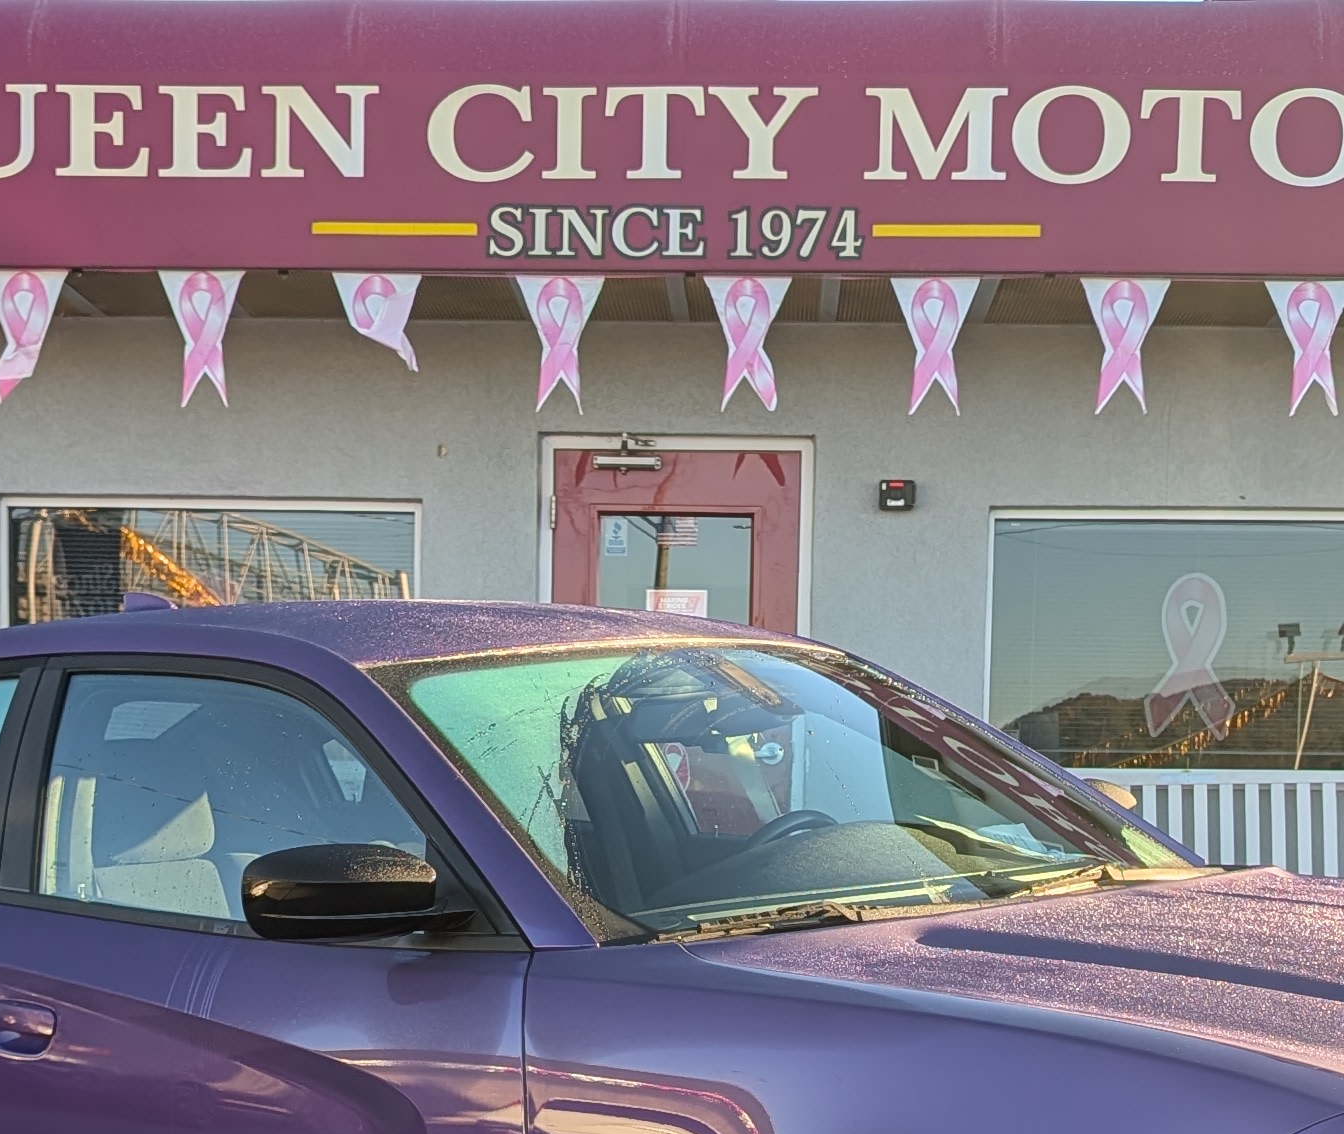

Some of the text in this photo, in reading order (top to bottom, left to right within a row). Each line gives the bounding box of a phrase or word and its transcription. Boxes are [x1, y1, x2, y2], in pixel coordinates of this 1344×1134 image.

[425, 84, 819, 184] CITY
[486, 205, 863, 260] SINCE 1974
